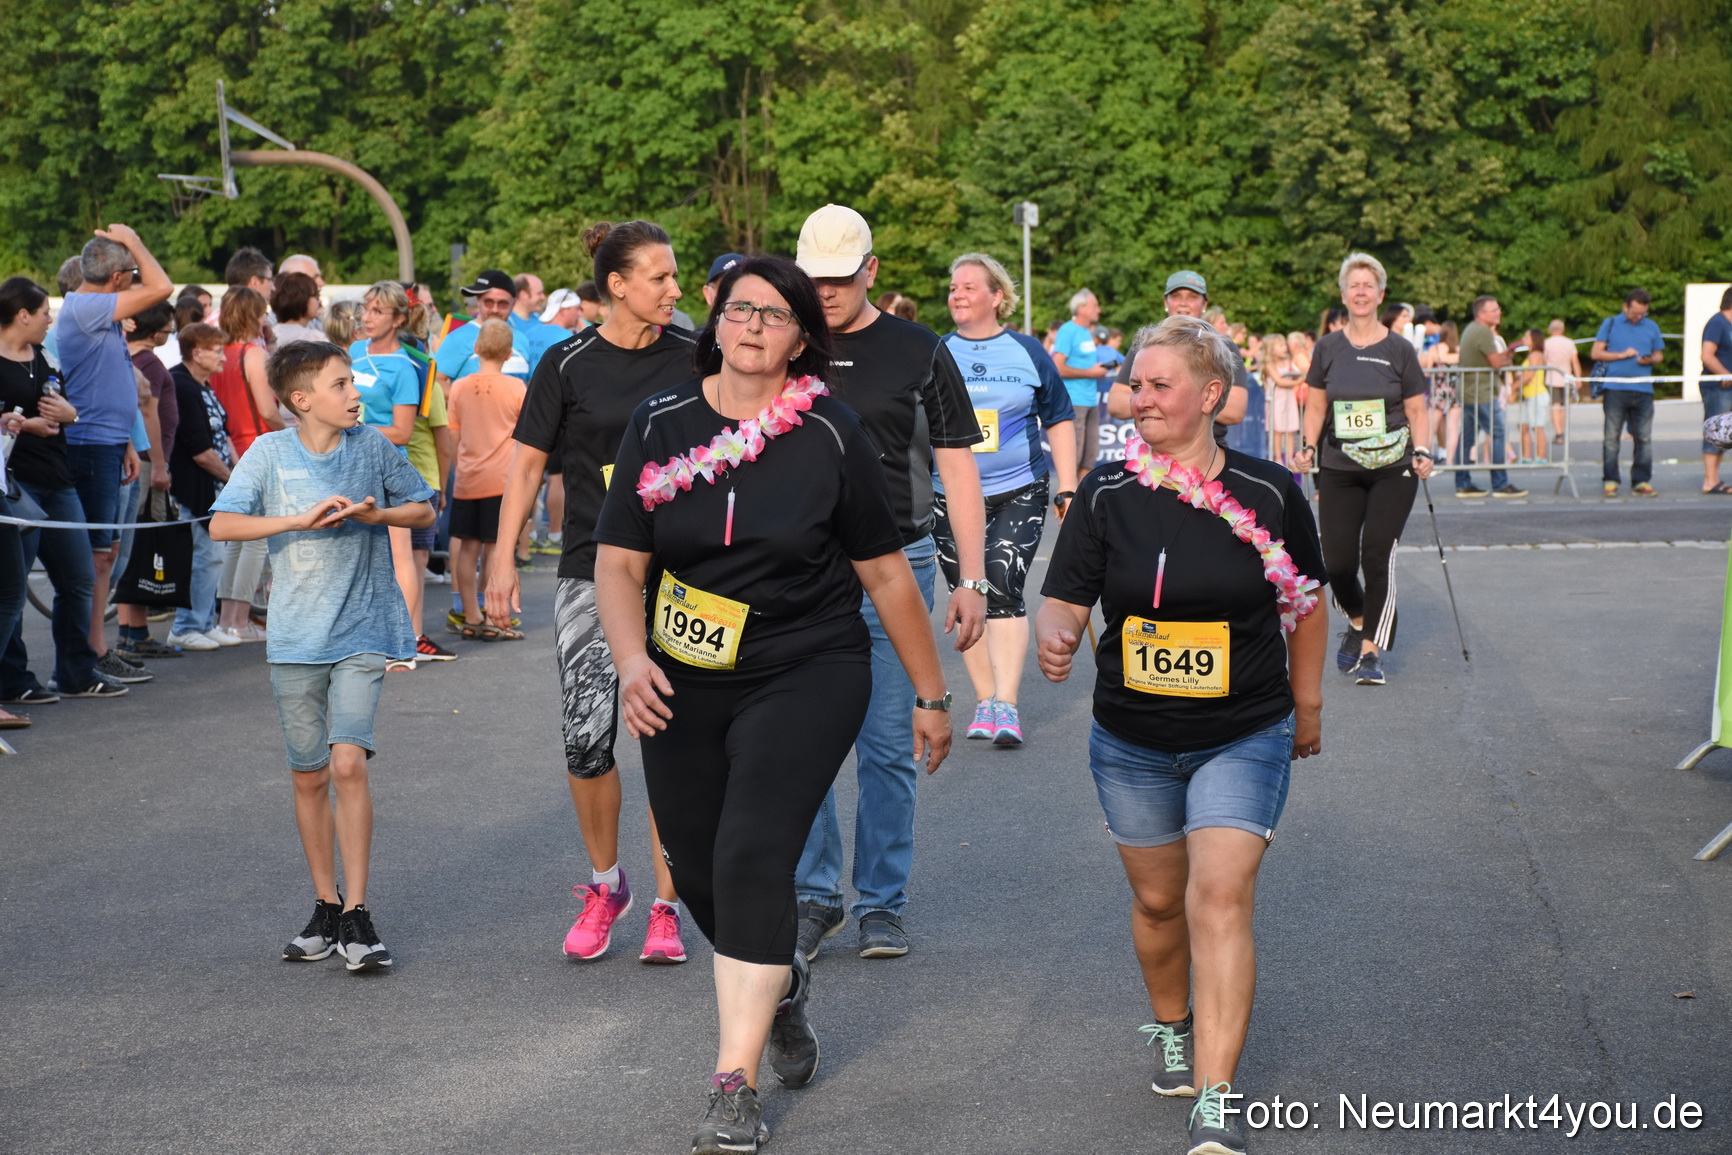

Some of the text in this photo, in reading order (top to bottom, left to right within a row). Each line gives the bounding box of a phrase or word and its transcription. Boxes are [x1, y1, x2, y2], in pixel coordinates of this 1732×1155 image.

[658, 394, 678, 404] JAKO
[1346, 414, 1373, 428] 165
[1107, 471, 1124, 480] JAKO
[663, 604, 725, 652] 1994
[1135, 629, 1170, 640] firmenlauf
[683, 642, 717, 659] Marianne
[1136, 645, 1214, 676] 1649
[1129, 676, 1146, 685] Regens
[1149, 674, 1200, 685] Germes Lilly
